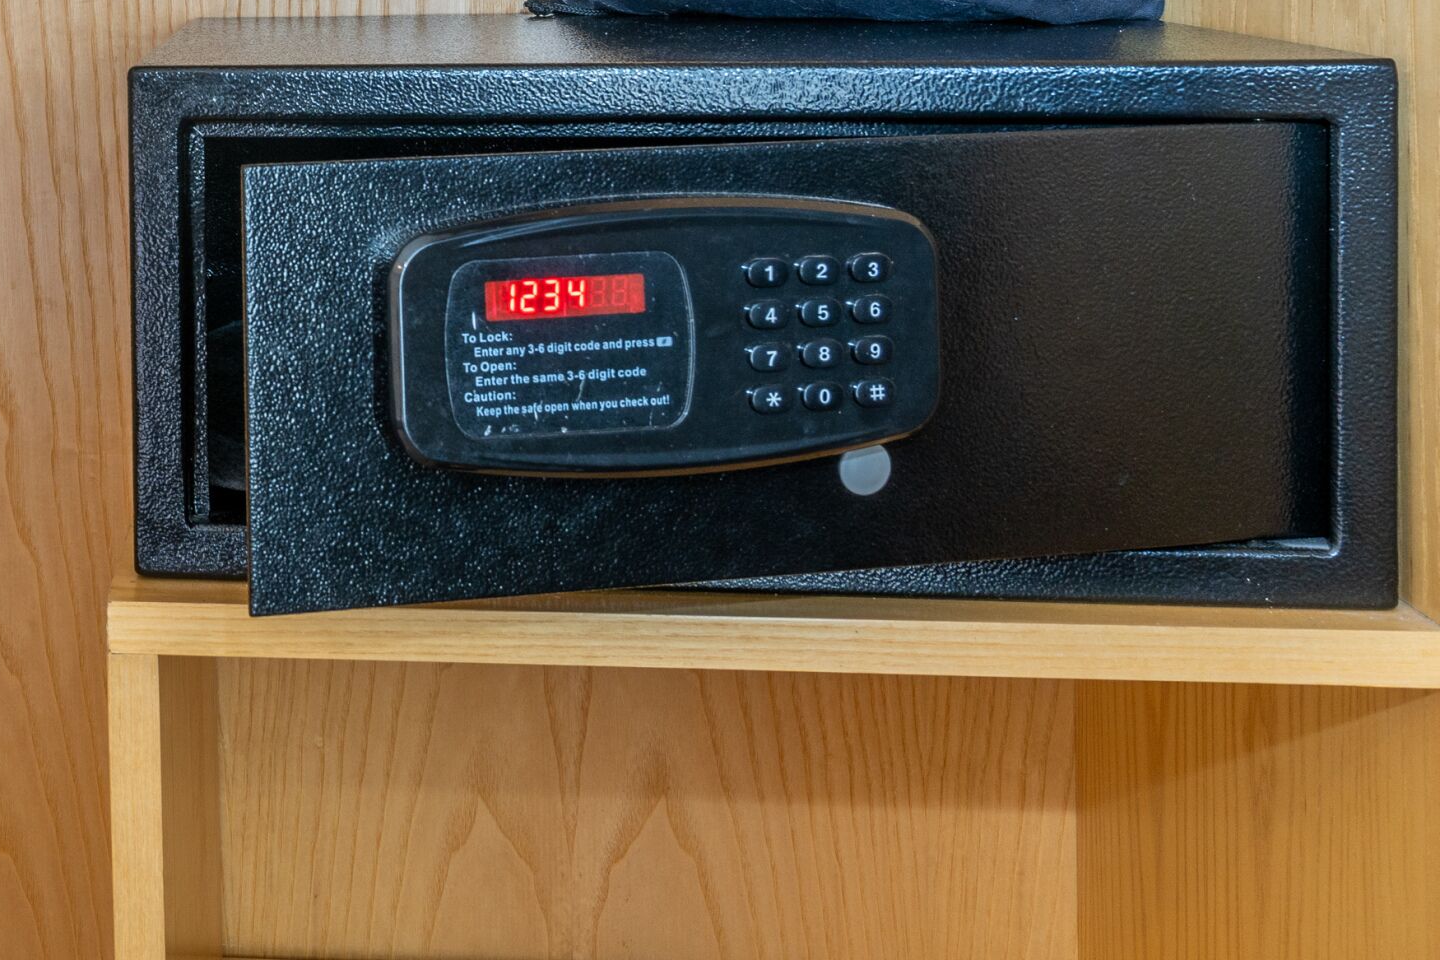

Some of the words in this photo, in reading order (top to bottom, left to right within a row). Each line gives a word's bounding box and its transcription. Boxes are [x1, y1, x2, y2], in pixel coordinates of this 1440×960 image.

[764, 265, 774, 282] 1
[816, 263, 828, 279] 2
[868, 262, 879, 277] 3
[509, 280, 585, 312] 1234
[765, 307, 777, 324] 4
[817, 305, 829, 320] 5
[870, 302, 881, 317] 6
[462, 333, 476, 344] To
[479, 332, 513, 343] Lock:
[474, 347, 504, 358] Enter
[506, 347, 525, 357] any
[528, 344, 544, 354] 3-6
[547, 342, 572, 355] digit
[574, 340, 600, 351] code
[602, 339, 623, 350] and
[625, 338, 654, 350] press
[819, 346, 830, 361] 8
[870, 343, 881, 359] 9
[766, 350, 778, 367] 7
[463, 362, 477, 373] To
[480, 361, 516, 373] Open:
[476, 376, 508, 386] Enter
[511, 374, 529, 384] the
[532, 374, 564, 383] same
[567, 370, 585, 380] 3-6
[588, 369, 615, 381] digit
[617, 366, 646, 377] code
[464, 392, 516, 403] Caution:
[870, 384, 885, 400] #
[476, 405, 501, 417] Keep
[504, 404, 519, 415] the
[522, 402, 543, 414] safe
[545, 401, 569, 413] open
[572, 399, 597, 411] when
[600, 399, 617, 411] you
[620, 396, 648, 408] check
[650, 394, 670, 405] out!
